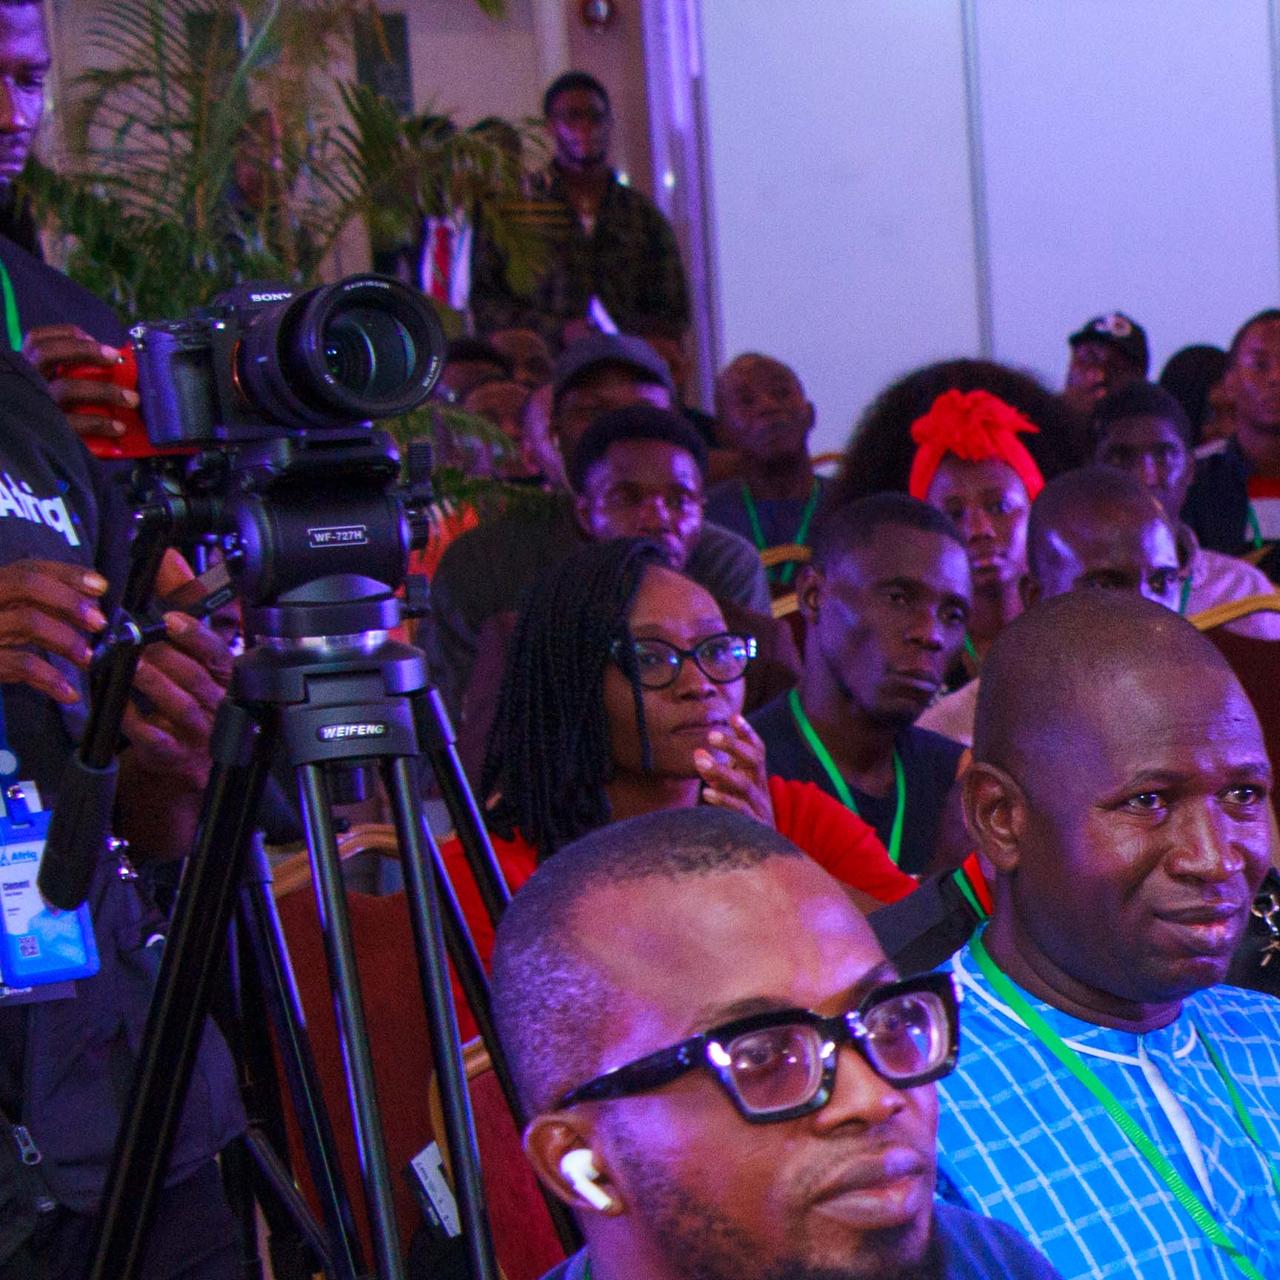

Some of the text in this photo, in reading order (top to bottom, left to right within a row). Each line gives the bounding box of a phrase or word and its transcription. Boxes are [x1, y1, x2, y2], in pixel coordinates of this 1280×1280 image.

[251, 292, 292, 302] SONY
[313, 530, 362, 542] WF-727H
[323, 724, 385, 738] WEIFENG
